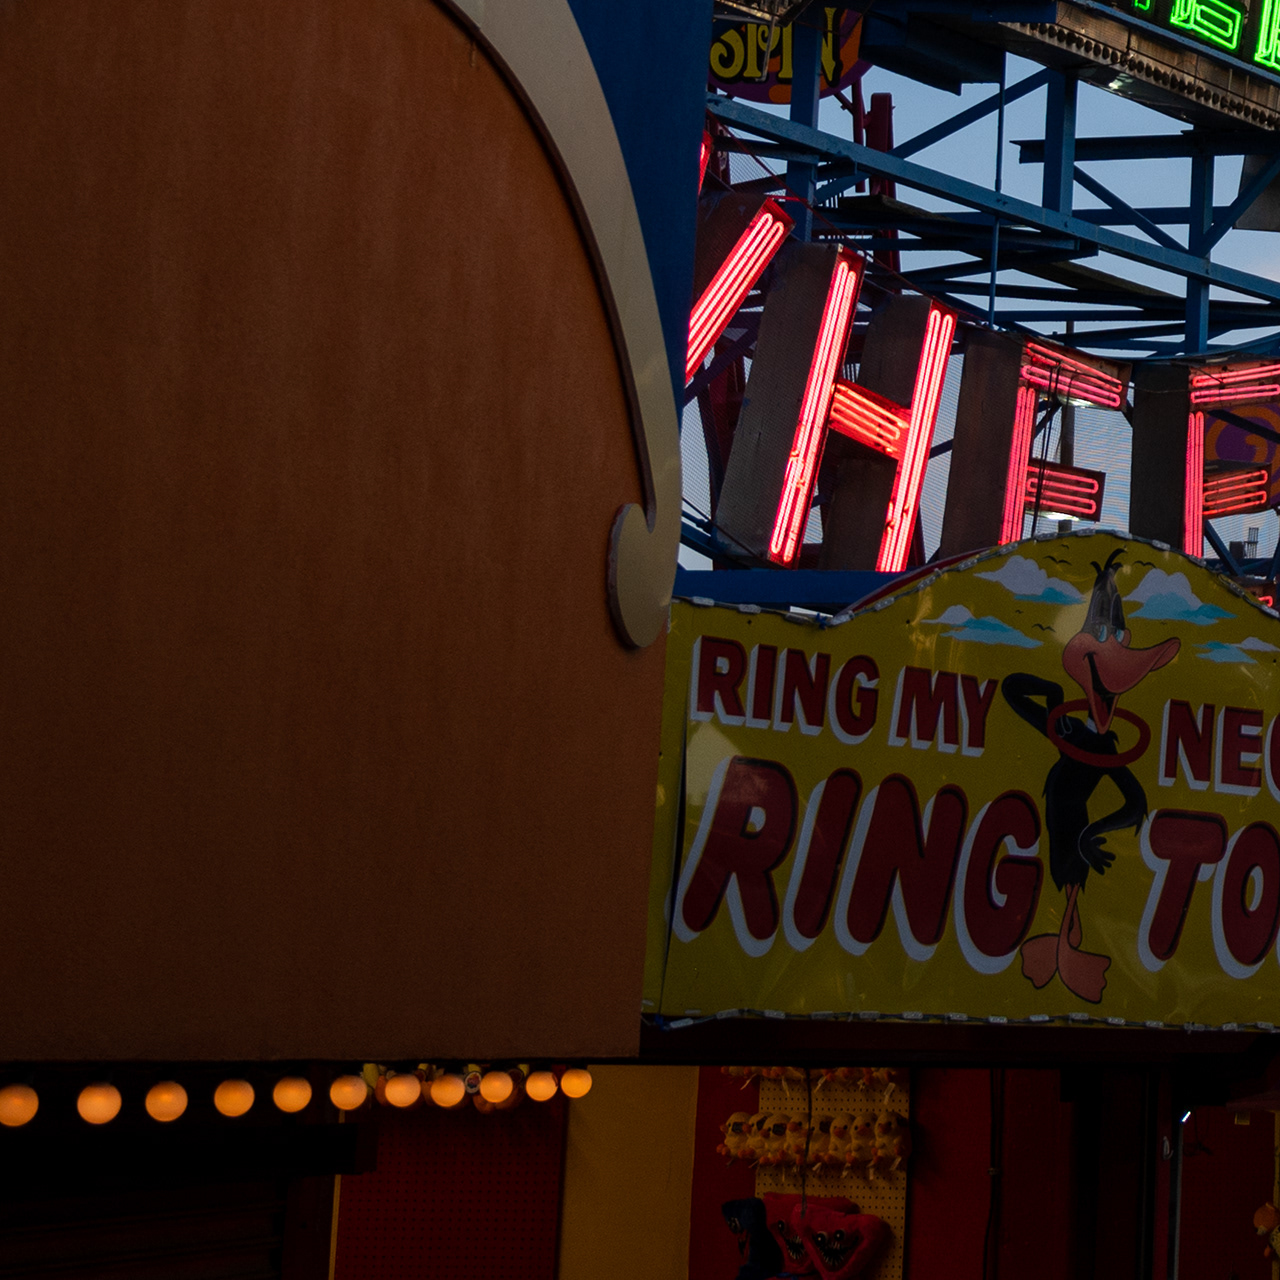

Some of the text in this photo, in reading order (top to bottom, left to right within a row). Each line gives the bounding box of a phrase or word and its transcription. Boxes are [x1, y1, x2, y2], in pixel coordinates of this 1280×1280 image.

[692, 634, 999, 757] RING MY
[674, 756, 1044, 974] RING
